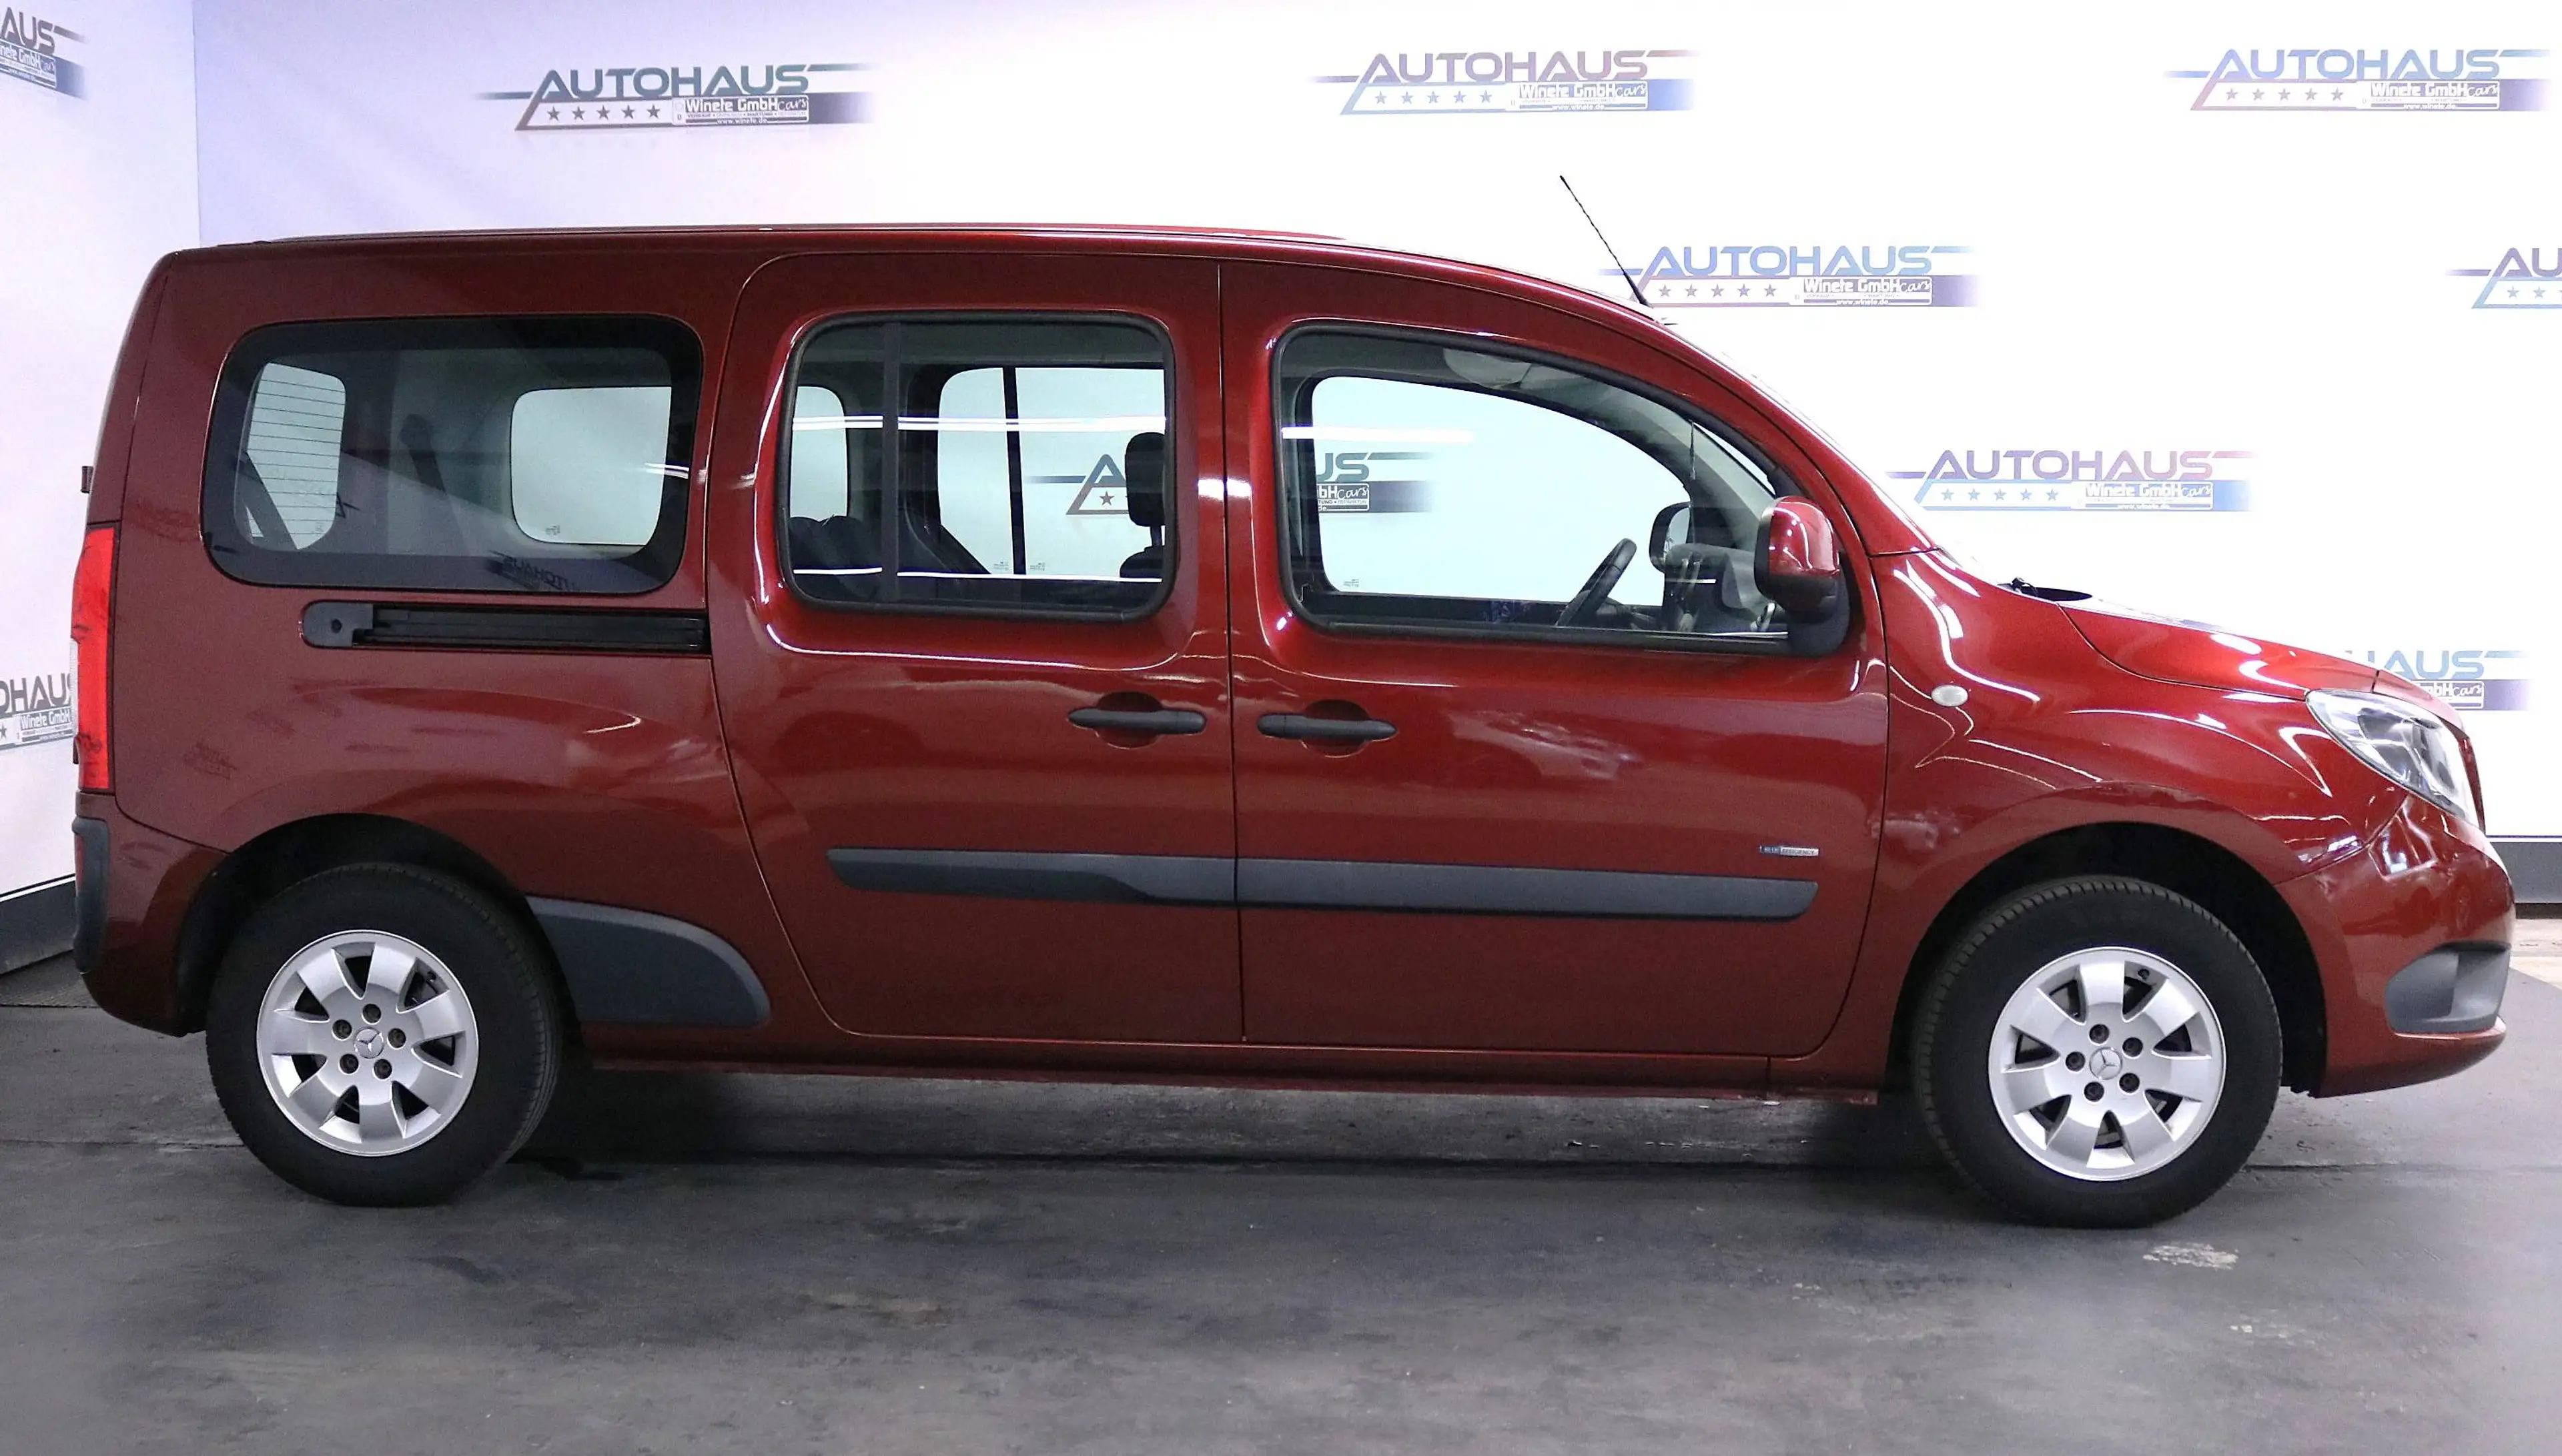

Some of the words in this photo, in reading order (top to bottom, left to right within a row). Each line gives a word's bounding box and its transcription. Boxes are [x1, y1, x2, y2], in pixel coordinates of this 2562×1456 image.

[1361, 50, 1647, 83] AUTOHAUS
[2216, 49, 2500, 79] AUTOHAUS
[536, 64, 809, 99] AUTOHAUS
[1645, 245, 1931, 276] AUTOHAUS
[1928, 450, 2212, 480] AUTOHAUS
